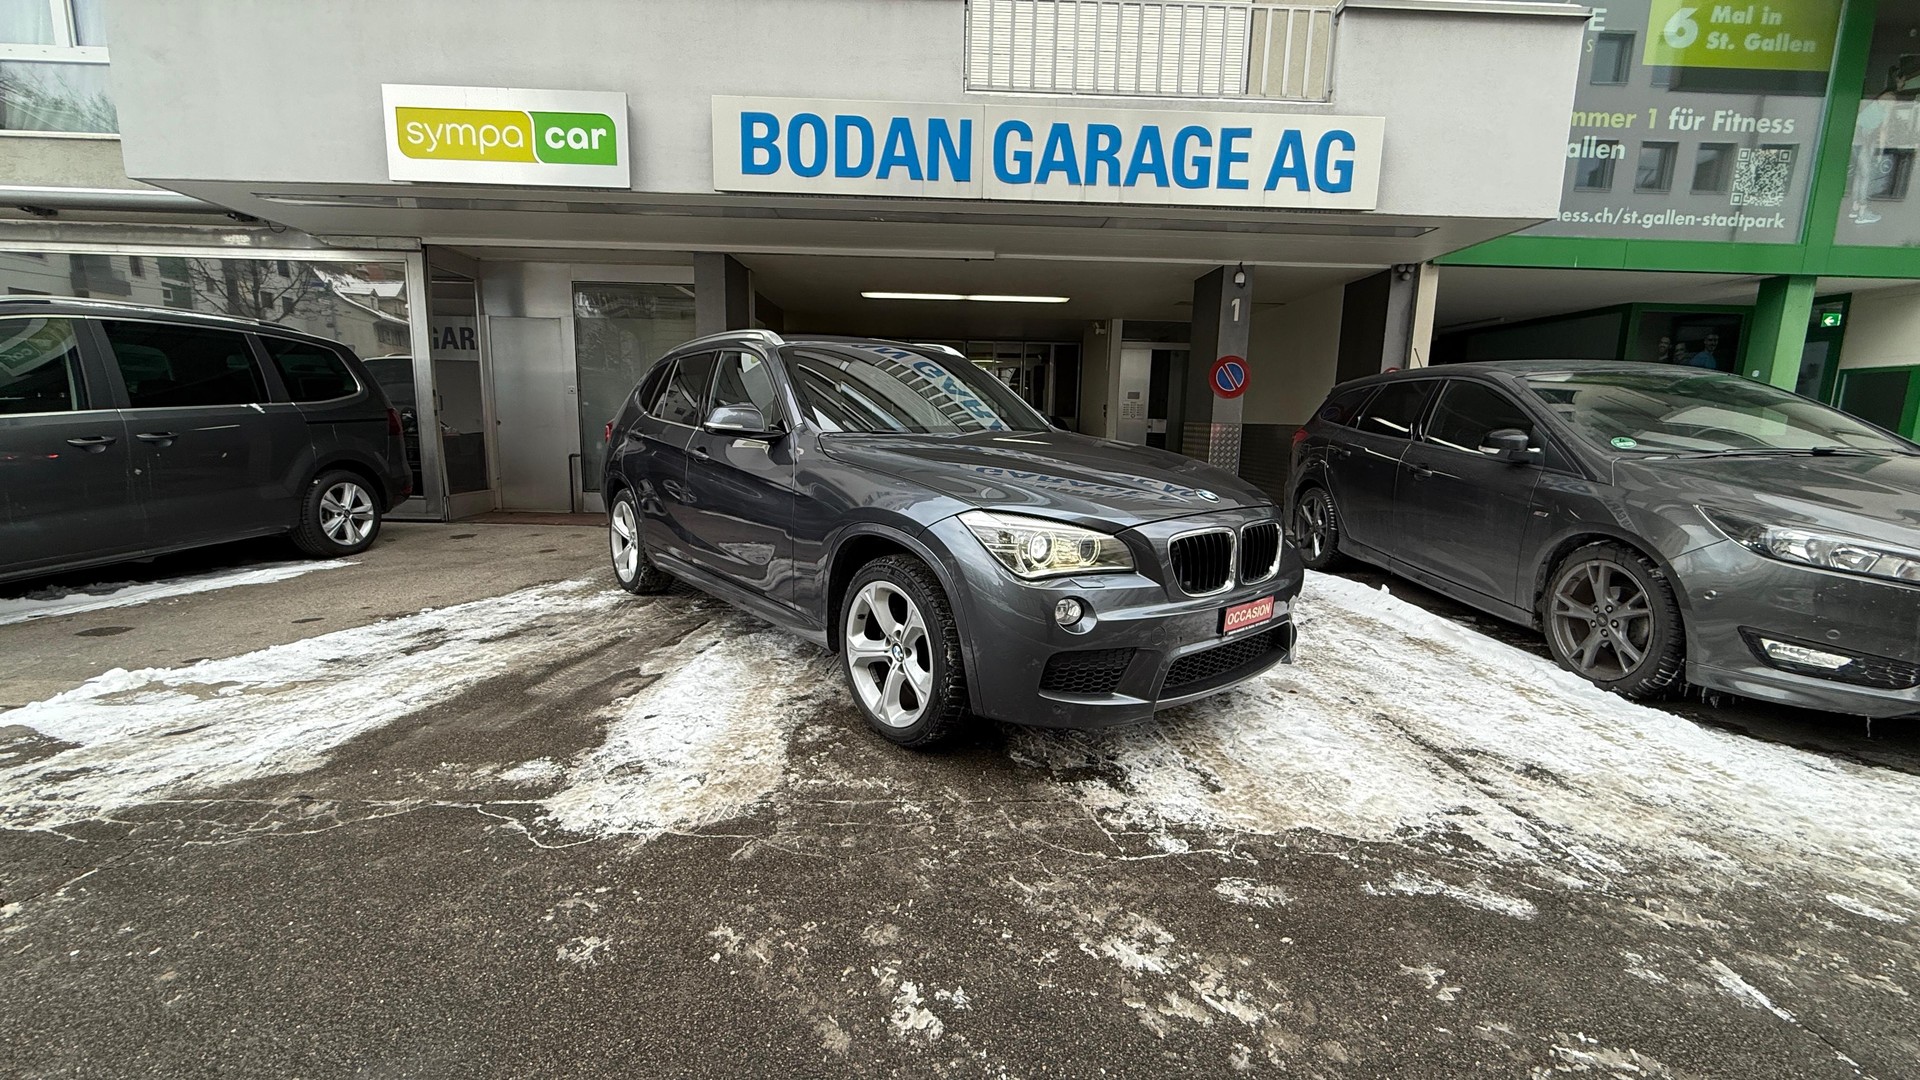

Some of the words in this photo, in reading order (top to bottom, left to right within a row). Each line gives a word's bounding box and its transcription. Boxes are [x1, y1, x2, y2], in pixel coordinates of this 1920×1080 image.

[1710, 5, 1753, 25] Mal
[1761, 6, 1783, 25] in
[1664, 8, 1699, 49] 6
[1706, 31, 1735, 50] St.
[1744, 33, 1817, 53] Gallen
[1648, 108, 1658, 129] 1
[1668, 107, 1706, 130] für
[1711, 109, 1795, 134] Fitness
[406, 121, 524, 155] sympa
[544, 126, 607, 150] car
[1567, 135, 1626, 160] allen
[740, 111, 972, 183] BODAN
[992, 119, 1252, 191] GARAGE
[1264, 128, 1356, 194] AG
[1231, 298, 1240, 321] 1
[1227, 602, 1271, 626] OCCASION
